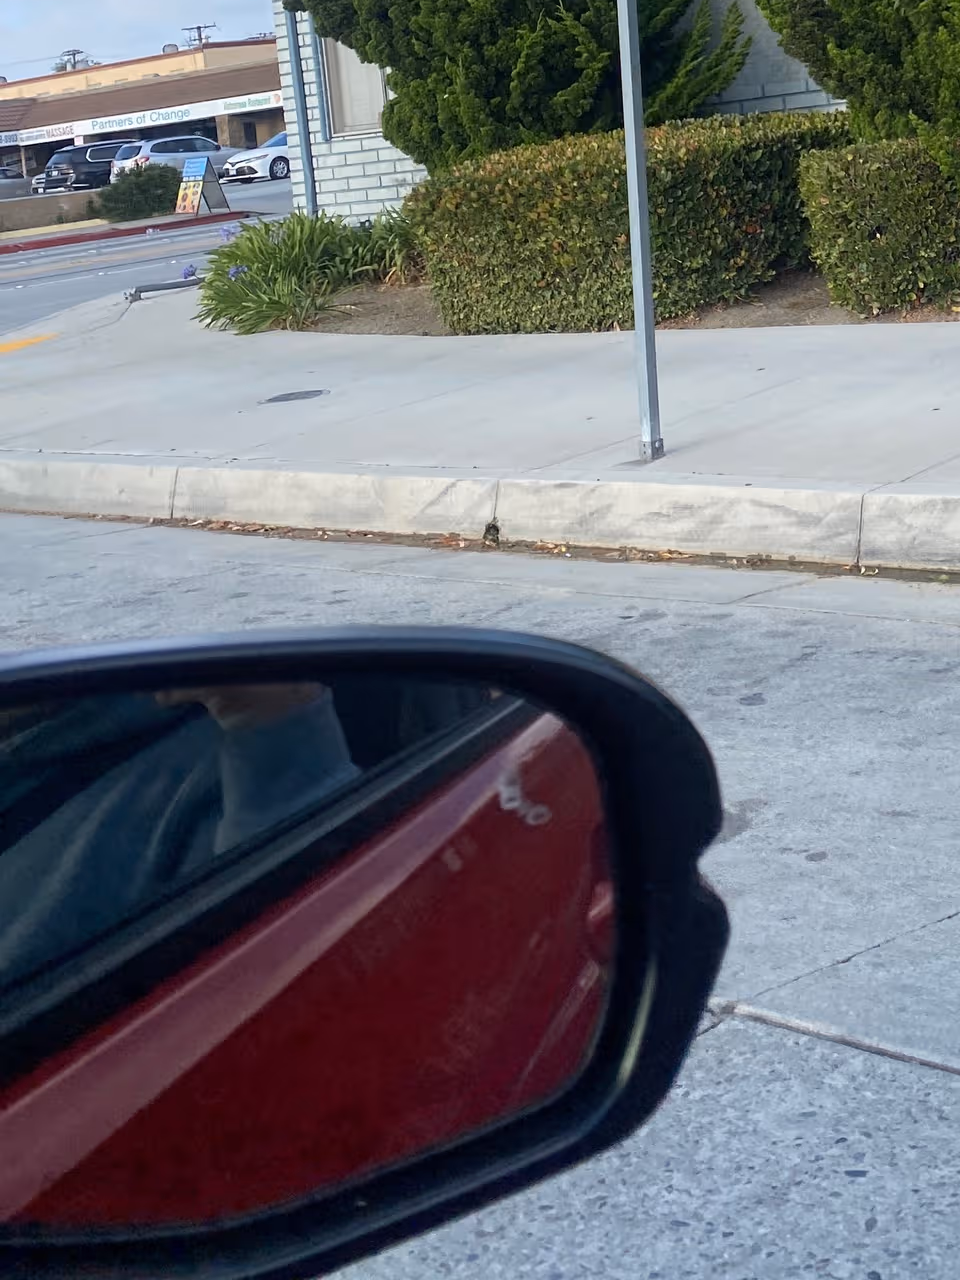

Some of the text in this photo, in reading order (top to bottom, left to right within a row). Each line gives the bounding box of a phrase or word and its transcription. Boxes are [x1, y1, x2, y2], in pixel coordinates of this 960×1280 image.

[91, 108, 191, 130] Partners of Change
[45, 125, 75, 138] MASSAGE
